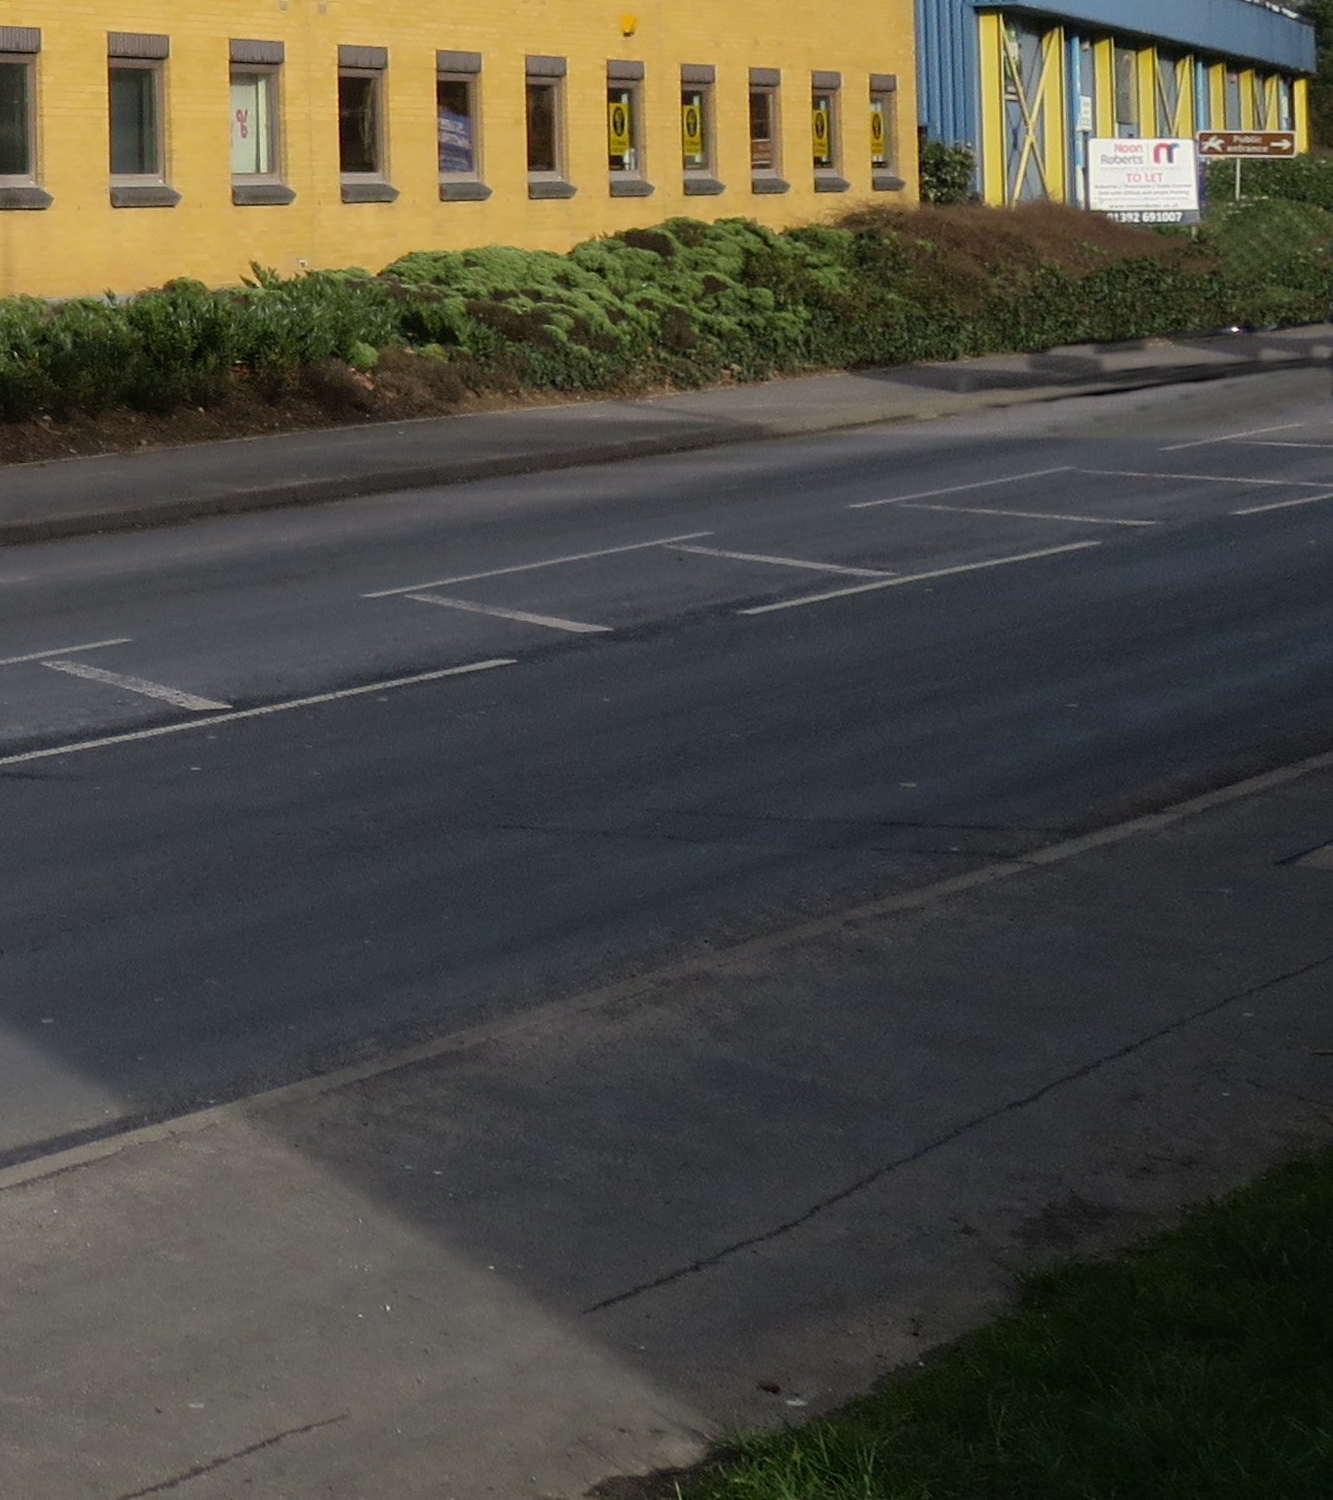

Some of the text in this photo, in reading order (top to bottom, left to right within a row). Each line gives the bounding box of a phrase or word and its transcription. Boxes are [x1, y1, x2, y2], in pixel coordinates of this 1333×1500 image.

[1114, 143, 1143, 153] Noon
[1100, 154, 1144, 165] Roberts
[1126, 172, 1164, 183] TO LET
[1141, 211, 1183, 222] 691007
